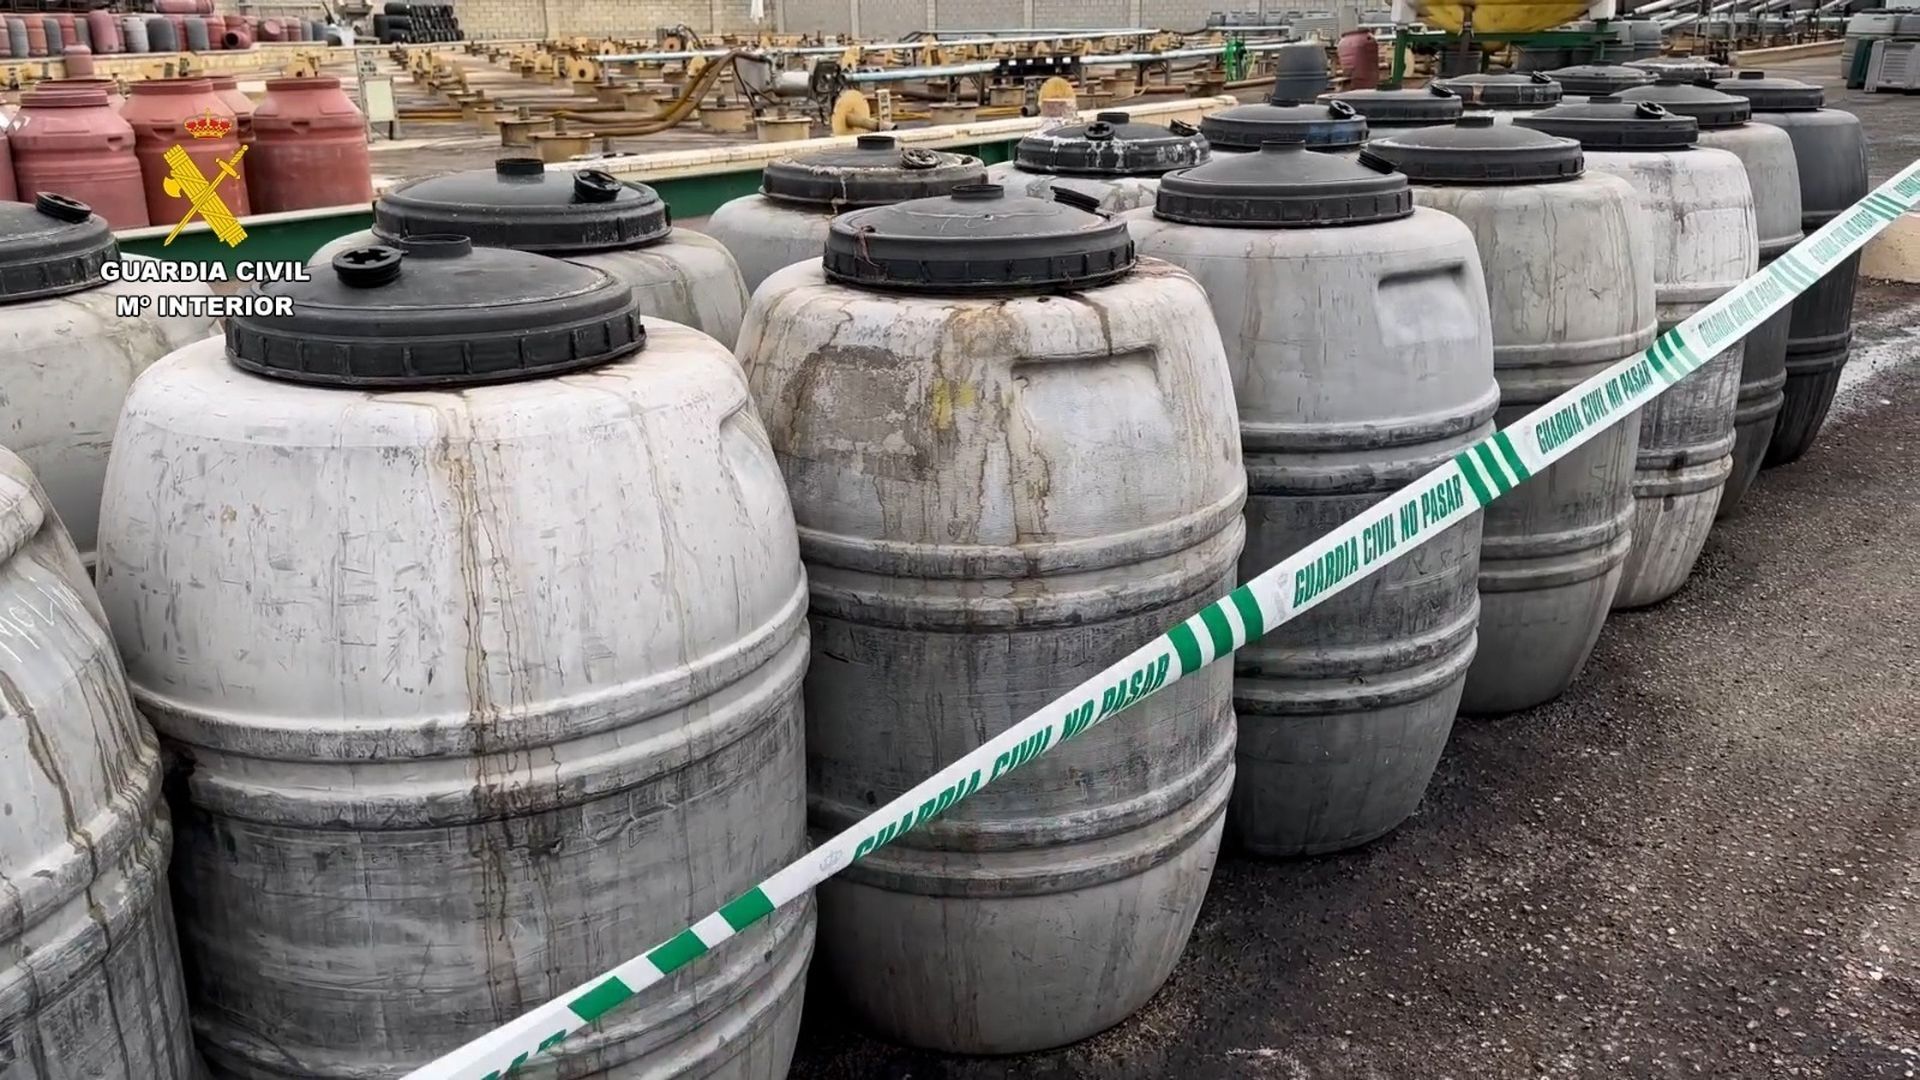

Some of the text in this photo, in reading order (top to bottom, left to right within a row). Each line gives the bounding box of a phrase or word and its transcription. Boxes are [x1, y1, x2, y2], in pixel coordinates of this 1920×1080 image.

[1535, 360, 1654, 455] GUARDIA CIVIL NO PASAR
[1293, 473, 1465, 609] GUARDIA CIVIL NO PASAR
[1058, 699, 1095, 744] NO
[1094, 652, 1171, 723] PASAR
